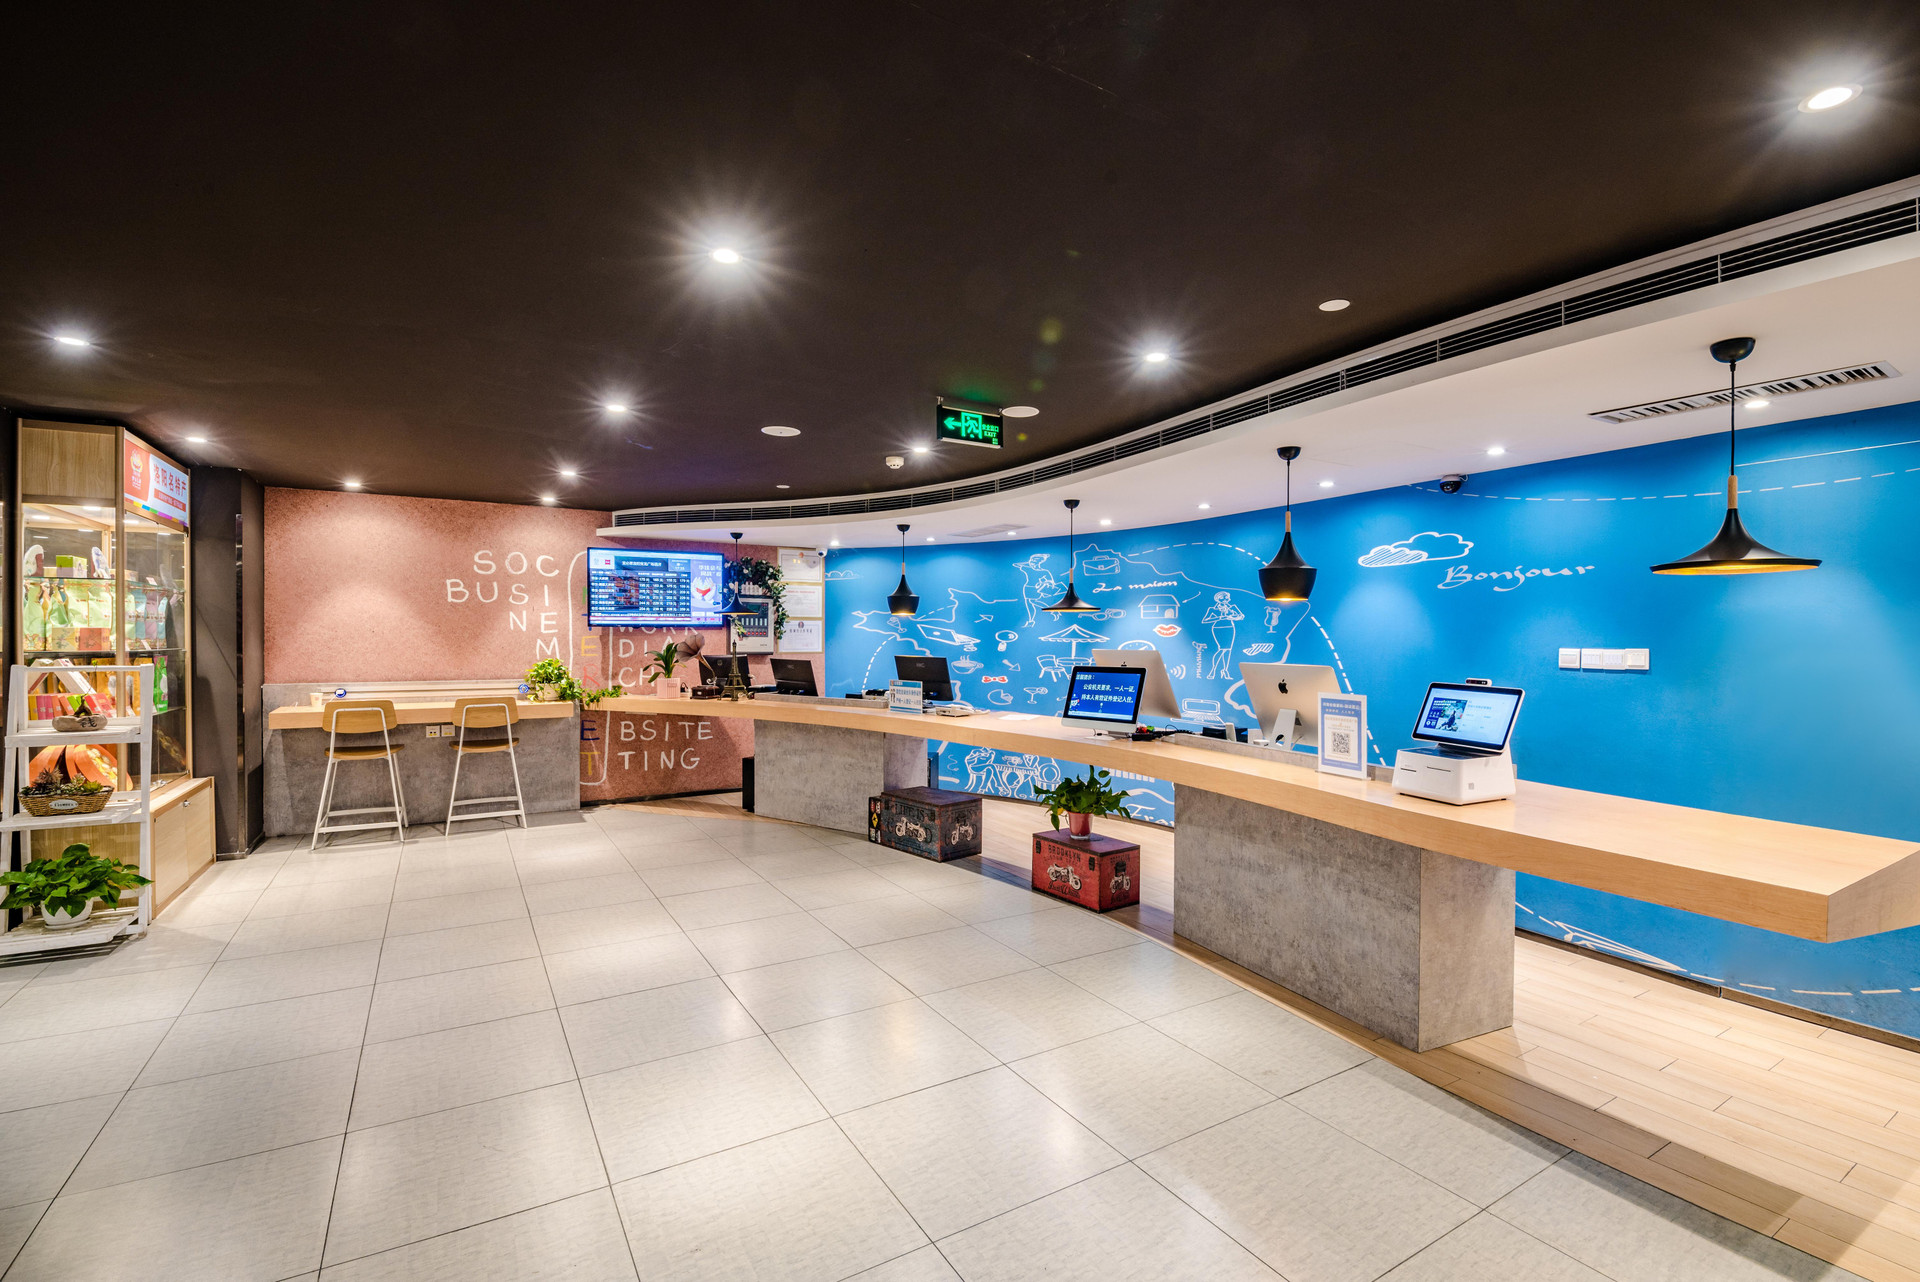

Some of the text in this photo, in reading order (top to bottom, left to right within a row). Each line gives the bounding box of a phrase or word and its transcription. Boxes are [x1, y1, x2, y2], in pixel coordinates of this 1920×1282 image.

[153, 463, 187, 497] 洛阳名特产
[473, 550, 560, 577] SOC
[1092, 581, 1178, 593] La maison
[1437, 565, 1595, 592] Bonjour
[446, 579, 549, 606] BUSI
[509, 610, 558, 634] NE
[535, 636, 560, 660] M
[619, 719, 714, 742] BSITE
[617, 747, 701, 771] TING
[1048, 844, 1081, 862] BROOKLYN
